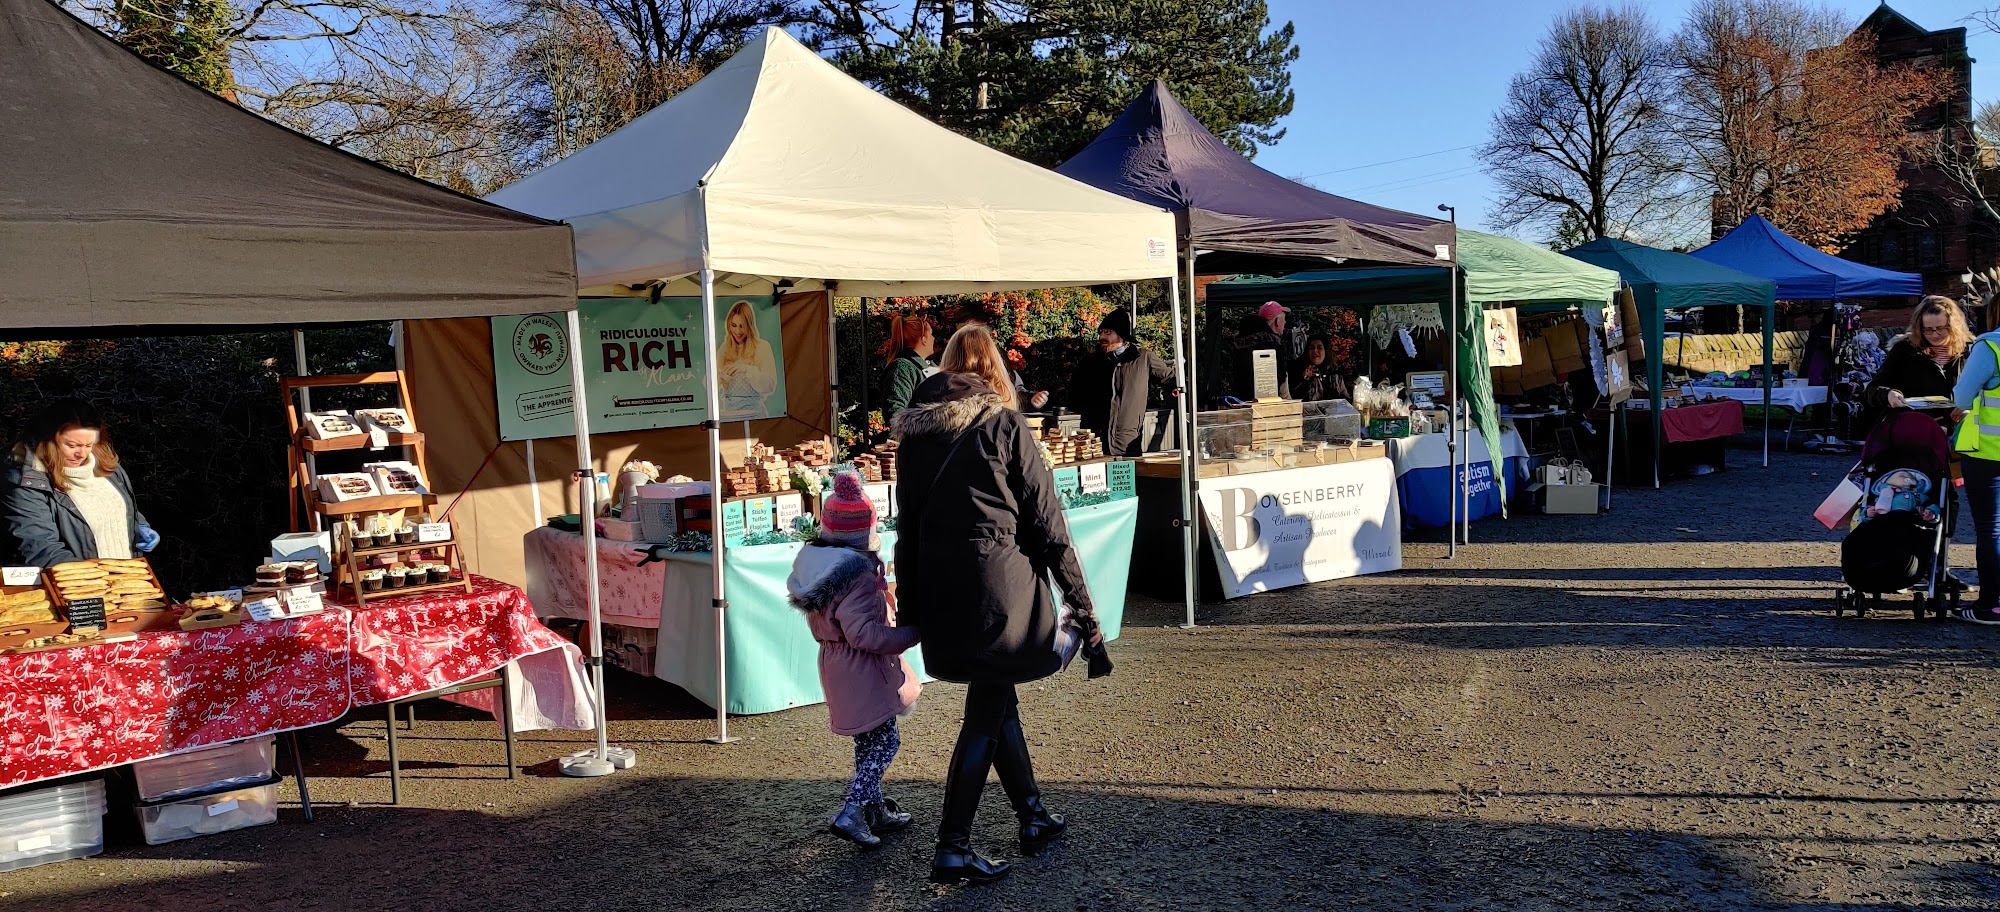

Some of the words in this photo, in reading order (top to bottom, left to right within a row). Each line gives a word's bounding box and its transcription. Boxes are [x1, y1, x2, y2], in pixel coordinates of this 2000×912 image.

[516, 326, 526, 346] MADE
[524, 321, 531, 329] IN
[531, 318, 553, 328] WALES
[600, 327, 687, 340] RIDICULOUSLY
[519, 351, 543, 372] GWNAED
[544, 363, 557, 371] YNG
[602, 340, 692, 372] RICH
[522, 403, 536, 412] THE
[537, 397, 573, 409] APPRENTIC
[1082, 481, 1105, 489] Crunch
[751, 508, 768, 516] Sticky
[780, 509, 800, 517] Biscoff
[1307, 508, 1353, 523] Delicatessen
[1353, 506, 1361, 516] &
[749, 523, 771, 532] Flapjack
[1273, 532, 1303, 544] Artisan
[1305, 527, 1337, 541] Producer
[1361, 546, 1394, 561] Wirral
